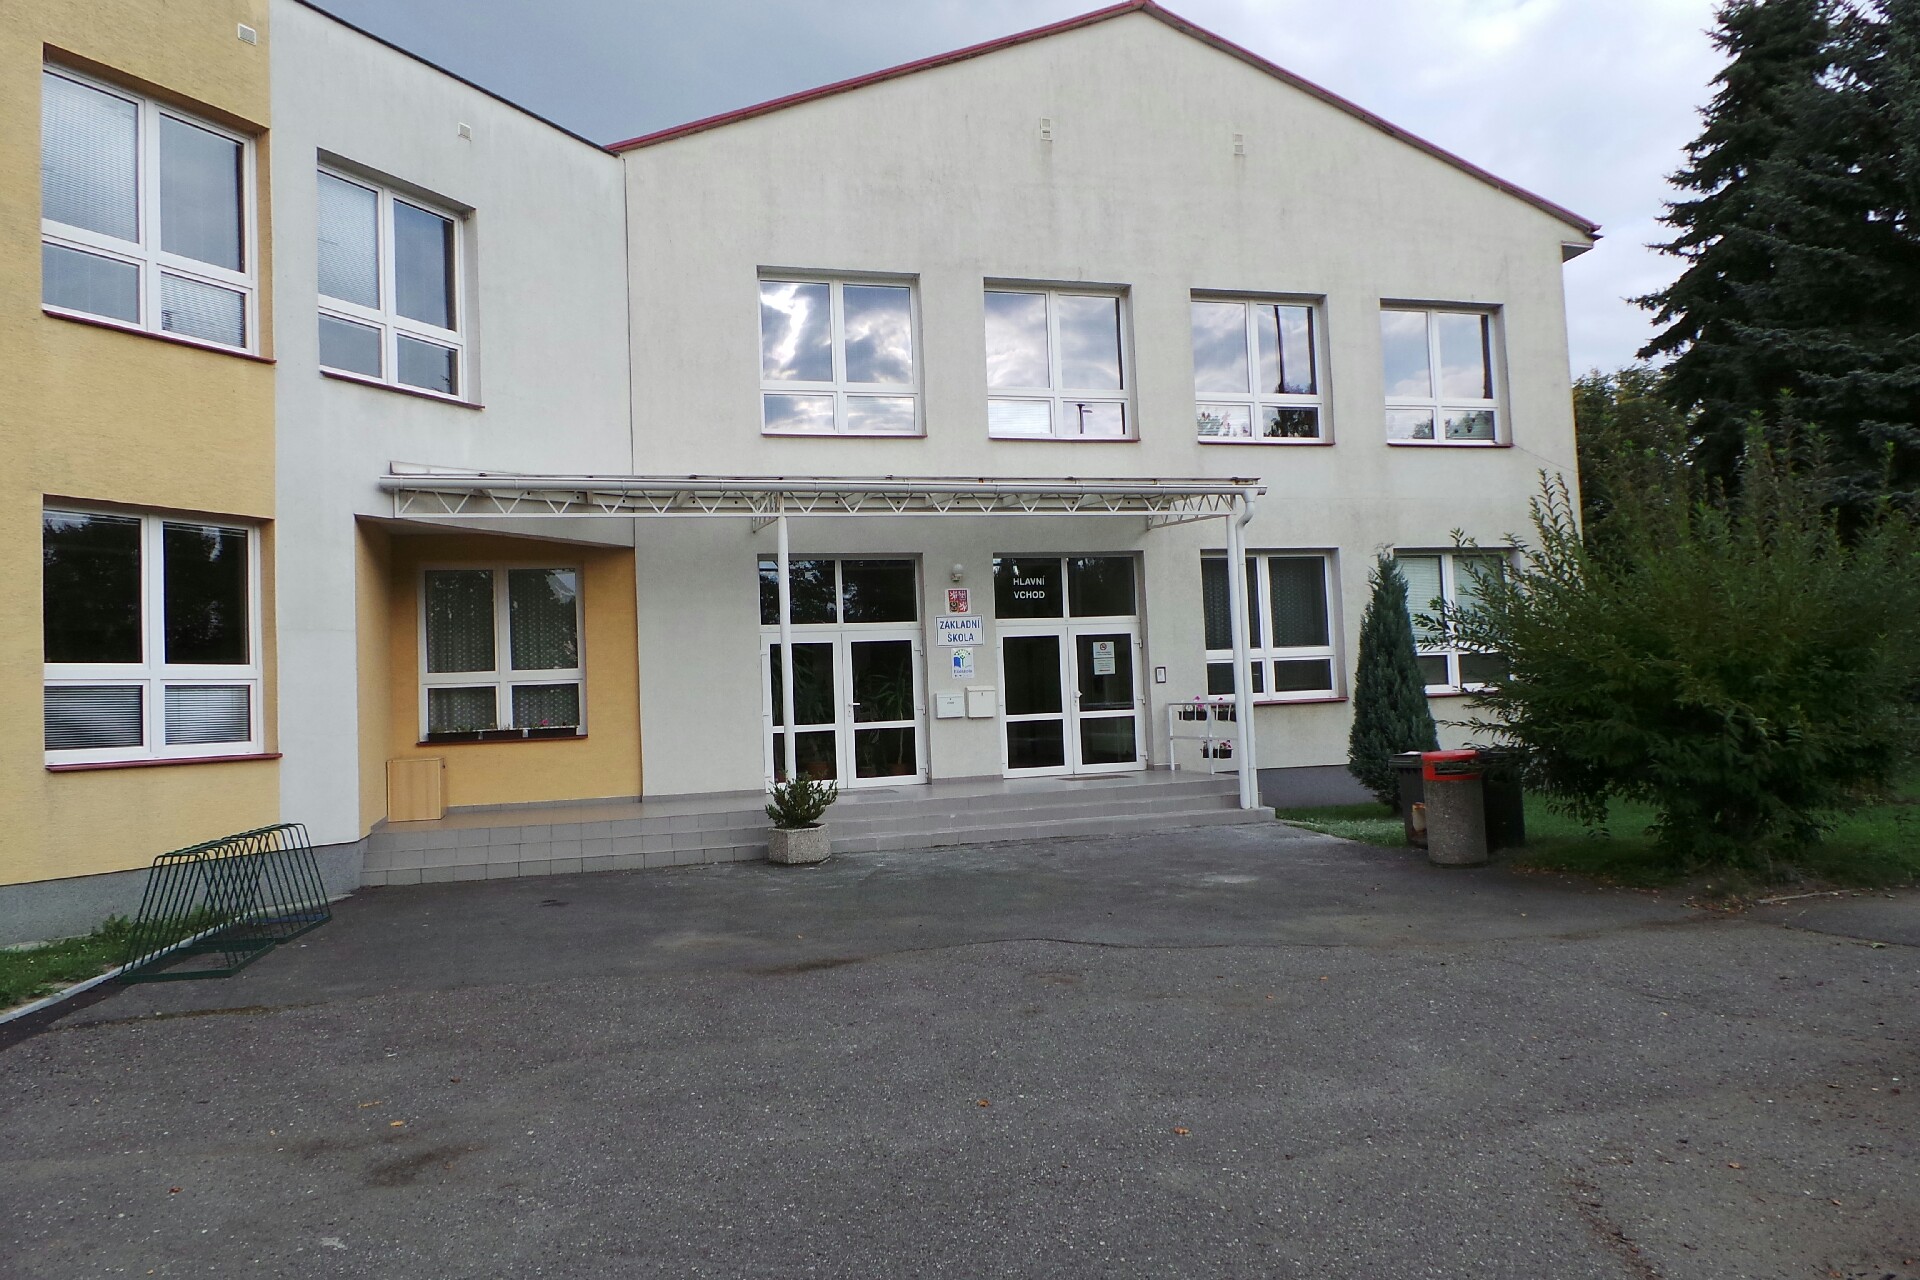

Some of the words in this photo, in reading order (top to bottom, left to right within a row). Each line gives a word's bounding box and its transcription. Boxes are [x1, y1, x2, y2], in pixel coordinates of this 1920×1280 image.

[1013, 575, 1045, 586] HLAVNÍ
[1013, 590, 1046, 599] VCHOD
[939, 618, 981, 630] ZÁKLADNÍ
[947, 632, 974, 642] ŠKOLA
